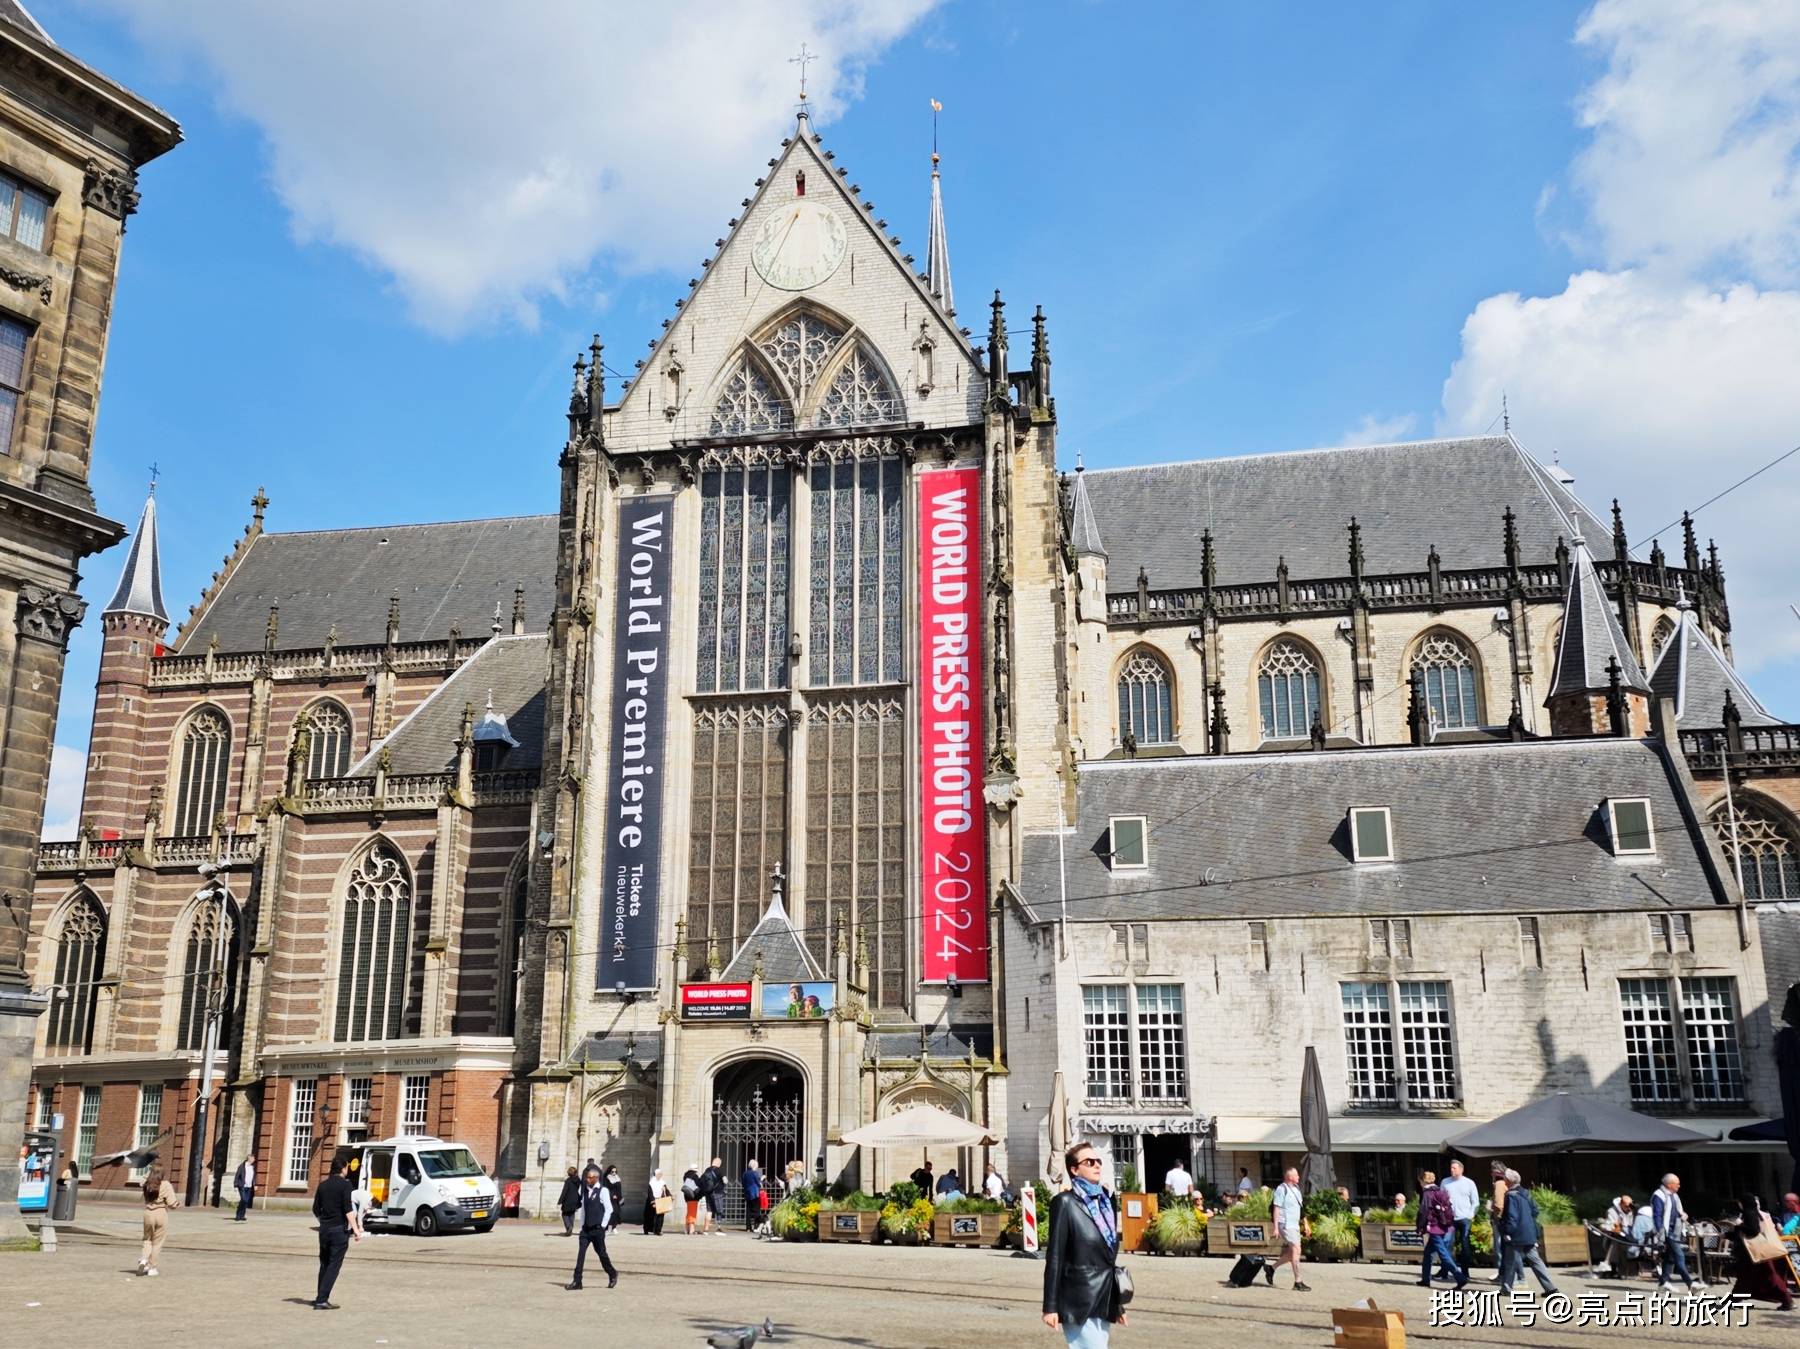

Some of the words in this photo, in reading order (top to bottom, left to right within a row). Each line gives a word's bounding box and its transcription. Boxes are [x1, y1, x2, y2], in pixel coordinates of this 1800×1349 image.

[628, 511, 663, 636] World
[931, 488, 968, 605] WORLD
[932, 613, 970, 712] PRESS
[618, 647, 658, 848] Premiere
[933, 720, 972, 834] PHOTO
[612, 865, 627, 963] nieuwekerknl
[629, 863, 644, 917] Tickets
[935, 852, 973, 962] 2024
[687, 990, 709, 999] WORLD
[709, 990, 727, 998] PRESS
[727, 989, 747, 998] PHOTO
[281, 1062, 328, 1071] MUSEUMWINKEL
[393, 1057, 438, 1066] MUSEUMSHOP
[1082, 1118, 1155, 1134] Nieuwe
